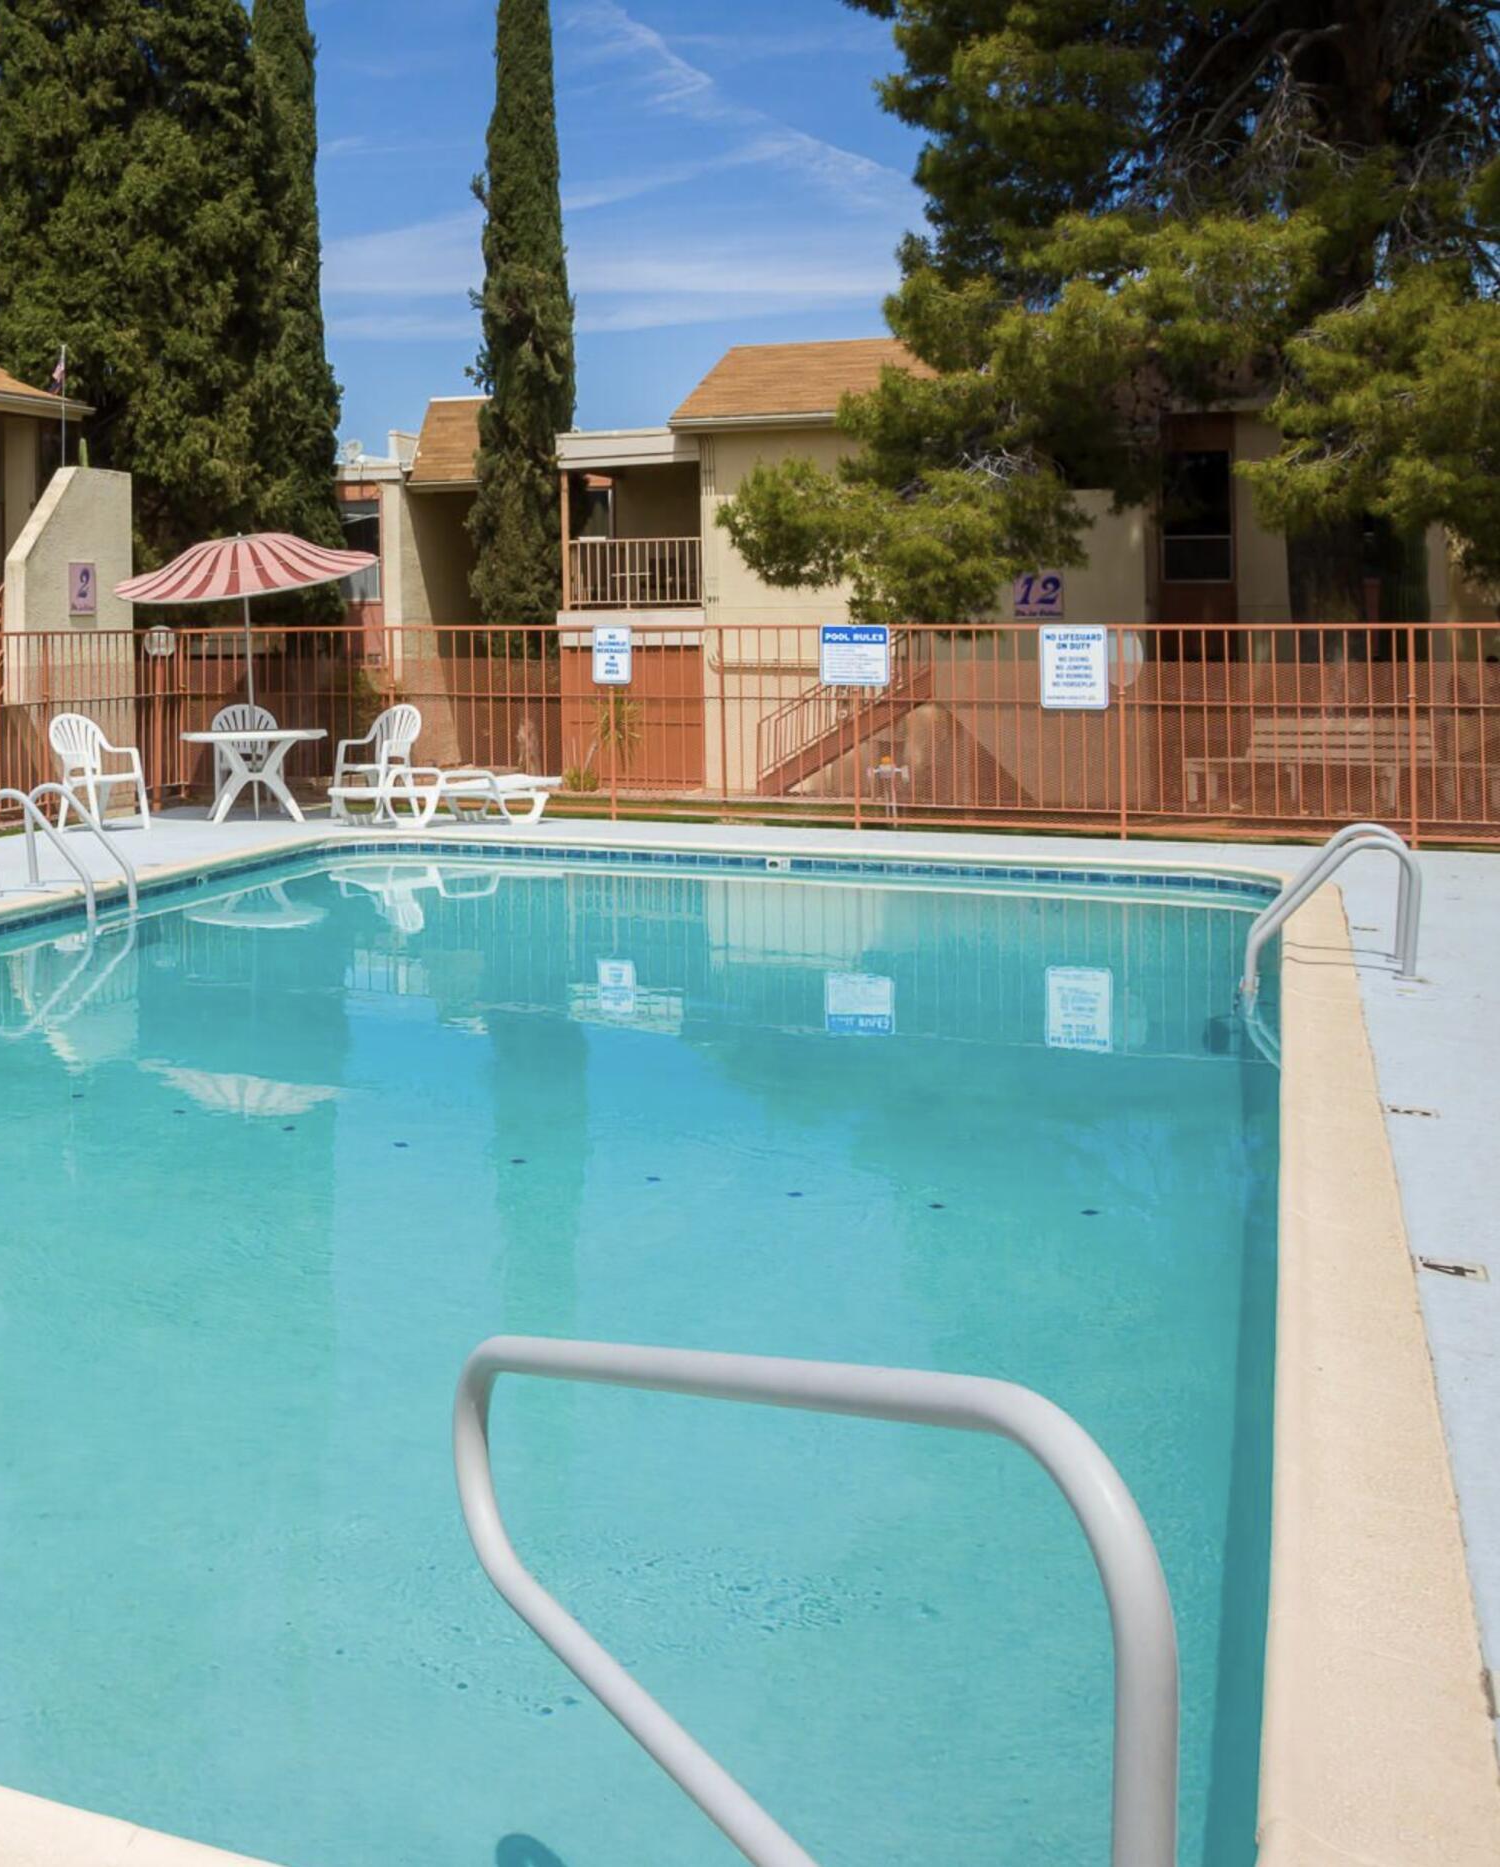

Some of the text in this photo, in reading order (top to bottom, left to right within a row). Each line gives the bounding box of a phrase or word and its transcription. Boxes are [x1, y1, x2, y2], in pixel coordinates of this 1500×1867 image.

[76, 567, 90, 598] 2
[1016, 576, 1061, 605] 12
[824, 633, 884, 641] POOL RULES
[1045, 633, 1102, 641] NO LIFEGUARD
